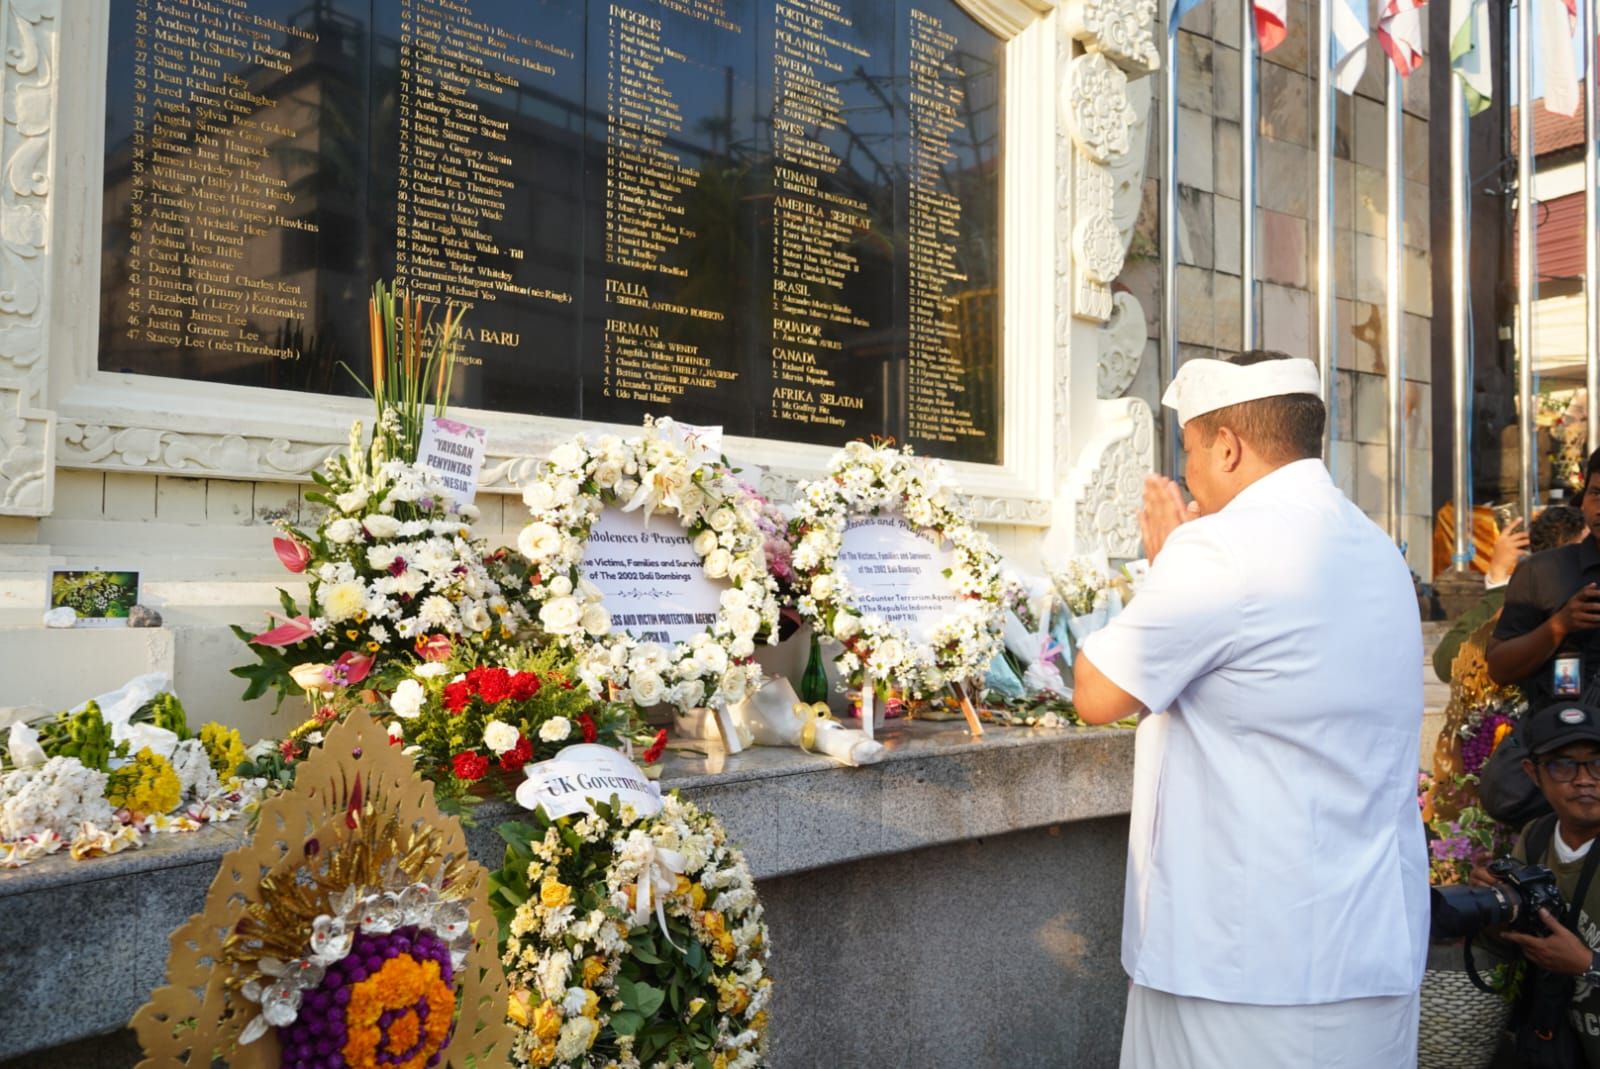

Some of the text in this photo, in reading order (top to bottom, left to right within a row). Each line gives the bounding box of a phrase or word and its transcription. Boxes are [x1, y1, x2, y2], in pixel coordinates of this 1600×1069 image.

[609, 4, 661, 31] INGGRIS
[190, 51, 220, 68] Dunn
[254, 54, 292, 75] Dunlop
[191, 65, 215, 80] John
[153, 84, 182, 100] Jared
[154, 70, 182, 86] Dean
[186, 78, 225, 96] Richard
[479, 114, 508, 129] Stewart
[774, 118, 804, 136] SWISS
[153, 125, 217, 148] Byron John
[474, 172, 513, 190] Thompson
[774, 165, 817, 188] YUNANI
[265, 188, 295, 205] Hardy
[774, 196, 871, 230] AMERIKA SERIKAT
[150, 221, 243, 246] Adam Howard
[275, 216, 318, 233] Hawkins
[149, 262, 180, 276] David
[278, 282, 300, 294] Kent
[605, 279, 648, 297] ITALIA
[773, 279, 811, 297] BRASIL
[148, 289, 198, 306] Elizabeth
[148, 303, 182, 317] Aaron
[147, 316, 180, 330] Justin
[239, 328, 258, 340] Lee
[605, 319, 659, 338] JERMAN
[773, 318, 822, 337] EQUADOR
[147, 330, 181, 346] Stacey
[185, 335, 204, 346] Lee
[481, 329, 519, 347] BARU
[772, 347, 816, 365] CANADA
[772, 387, 864, 409] AFRIKA SELATAN
[426, 454, 472, 477] PENYINTAS
[441, 475, 472, 493] NESIA"
[877, 517, 895, 526] and
[588, 530, 638, 543] ndolences
[641, 533, 649, 543] &
[594, 558, 626, 568] Victims,
[627, 559, 659, 567] Families
[660, 559, 675, 567] and
[675, 559, 703, 568] Surviv
[589, 571, 692, 582] of The 2002 Bali Bombings
[877, 605, 908, 613] Republic
[623, 614, 637, 625] AND
[637, 614, 657, 625] VICTIM
[658, 613, 694, 625] PROTECTION
[695, 613, 717, 624] AGENCY
[544, 775, 577, 797] UK
